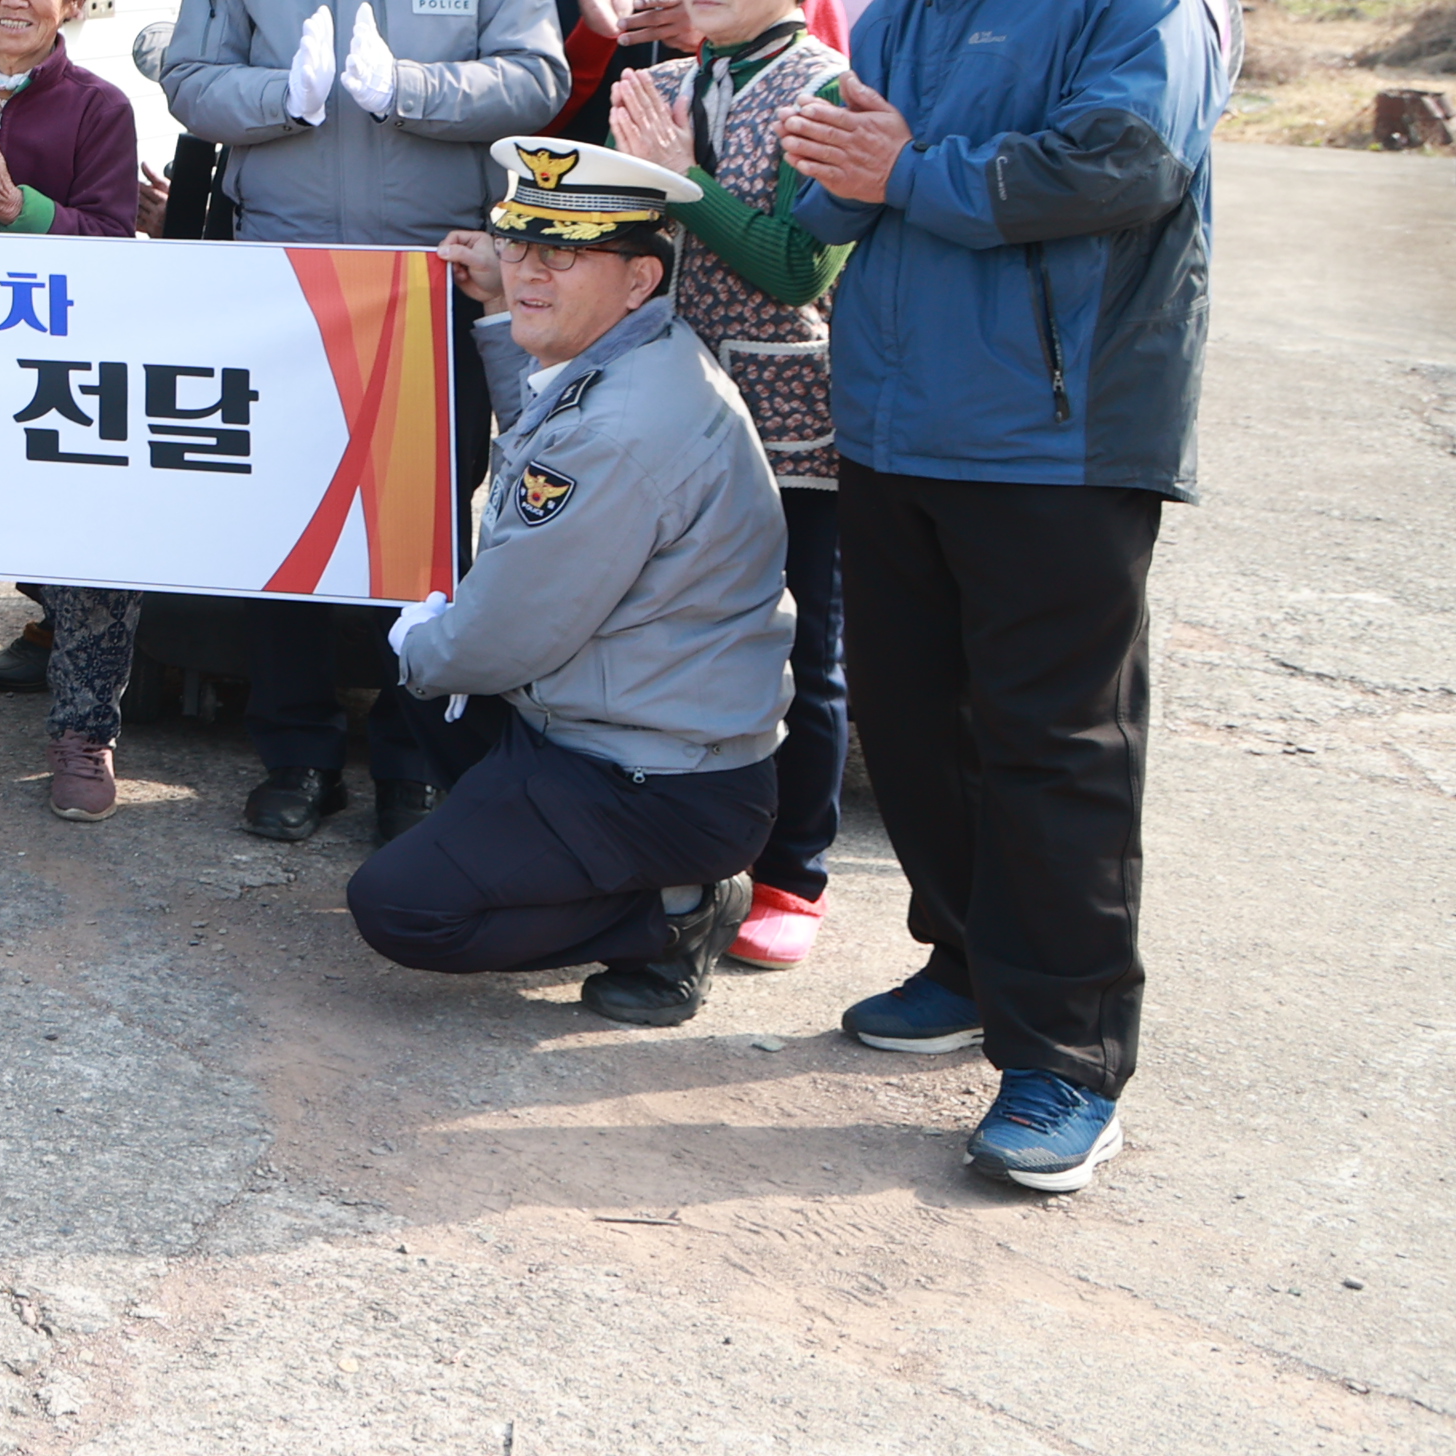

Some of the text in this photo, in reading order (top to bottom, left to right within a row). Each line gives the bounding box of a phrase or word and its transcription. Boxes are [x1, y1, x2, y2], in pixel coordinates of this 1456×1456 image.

[418, 0, 470, 9] POLICE
[12, 358, 260, 475] 전달
[521, 501, 545, 517] POLICE
